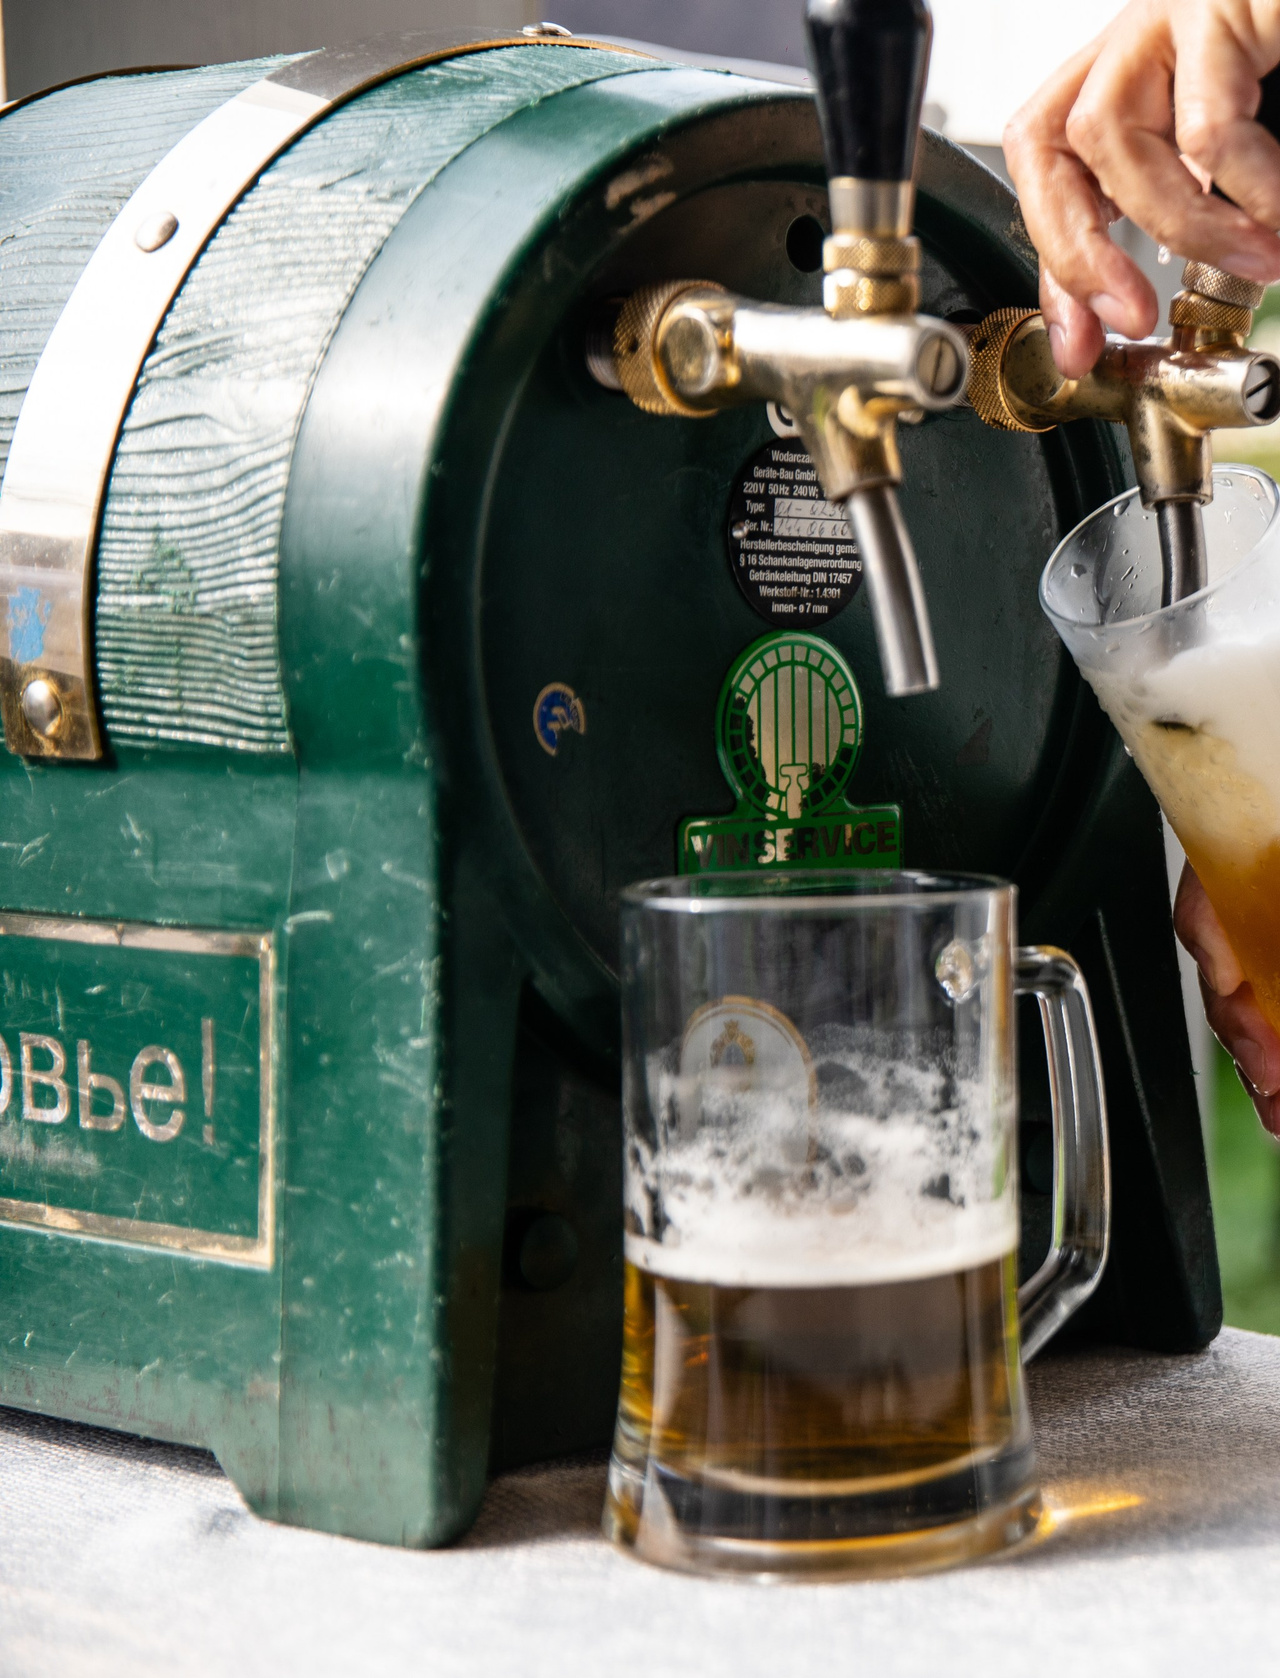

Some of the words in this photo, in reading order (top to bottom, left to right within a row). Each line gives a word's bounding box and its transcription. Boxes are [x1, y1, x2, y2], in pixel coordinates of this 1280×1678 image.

[771, 449, 815, 464] Wodarcza
[753, 465, 794, 481] Geräte-Bau
[795, 469, 817, 481] GmbH
[743, 481, 765, 495] 220V
[768, 483, 790, 496] 50Hz
[745, 500, 765, 514] Type:
[744, 518, 759, 532] Ser.
[760, 520, 774, 533] Nr.:
[740, 538, 835, 555] Herstellerbescheinigung
[835, 542, 859, 556] gemä
[739, 553, 745, 567] §
[747, 554, 757, 565] 16
[758, 554, 863, 572] Schankanlagenverordnung
[749, 569, 812, 585] Getränkeleitung
[812, 572, 828, 584] DIN
[828, 573, 853, 585] 17457
[759, 585, 815, 599] Werkstoff-Nr.:
[815, 587, 841, 600] 1.4301
[806, 602, 812, 613] 7
[812, 604, 829, 615] mm
[0, 1017, 214, 1146] вье!
